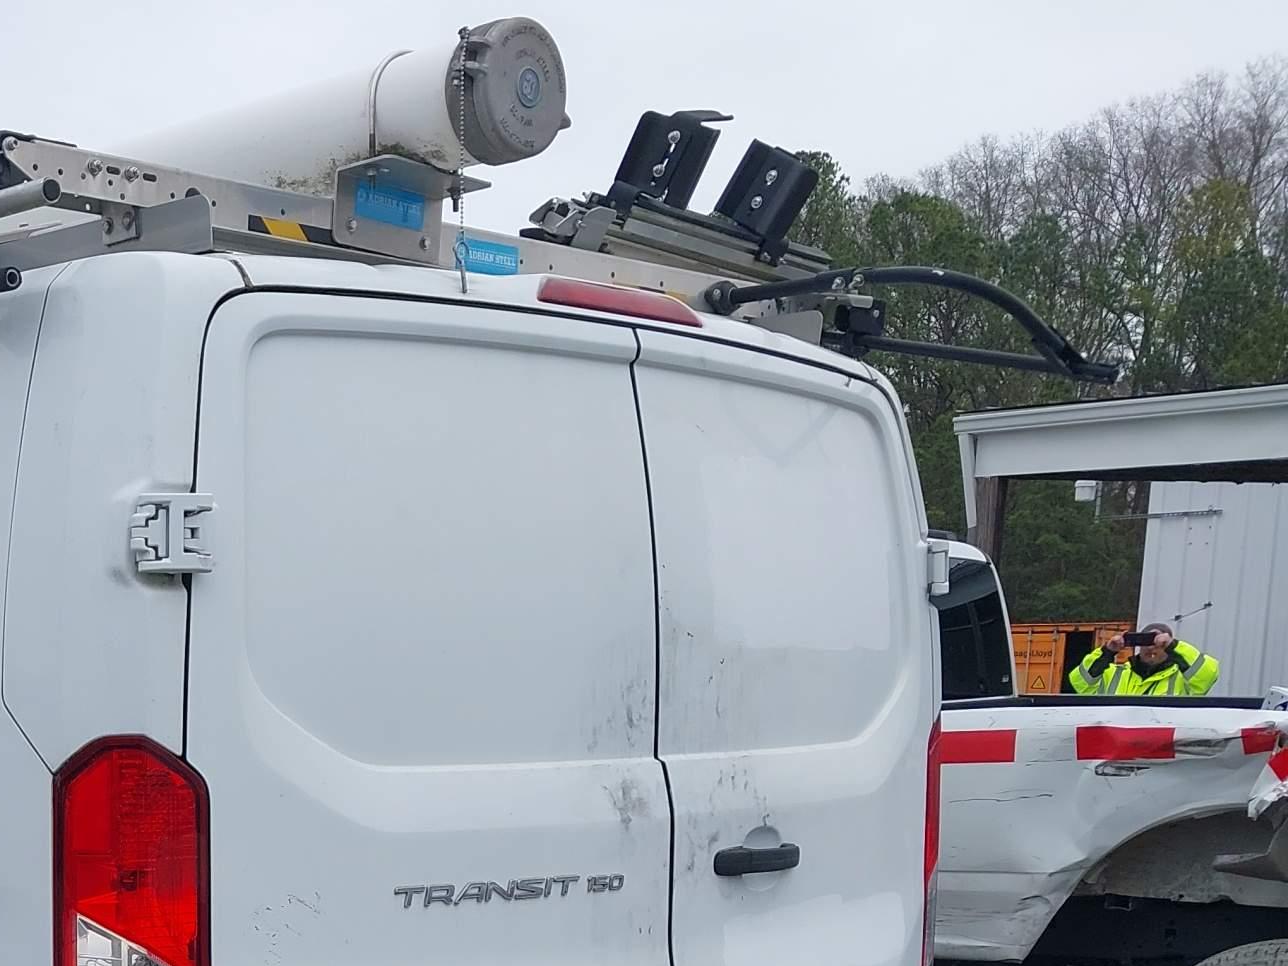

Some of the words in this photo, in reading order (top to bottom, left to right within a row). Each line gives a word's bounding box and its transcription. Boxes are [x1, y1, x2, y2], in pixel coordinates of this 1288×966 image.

[469, 249, 494, 263] ADRIAN
[495, 255, 516, 266] STEEL
[1014, 650, 1052, 658] ag-Lloyd
[393, 875, 580, 908] TRANSIT
[587, 874, 624, 893] 150
